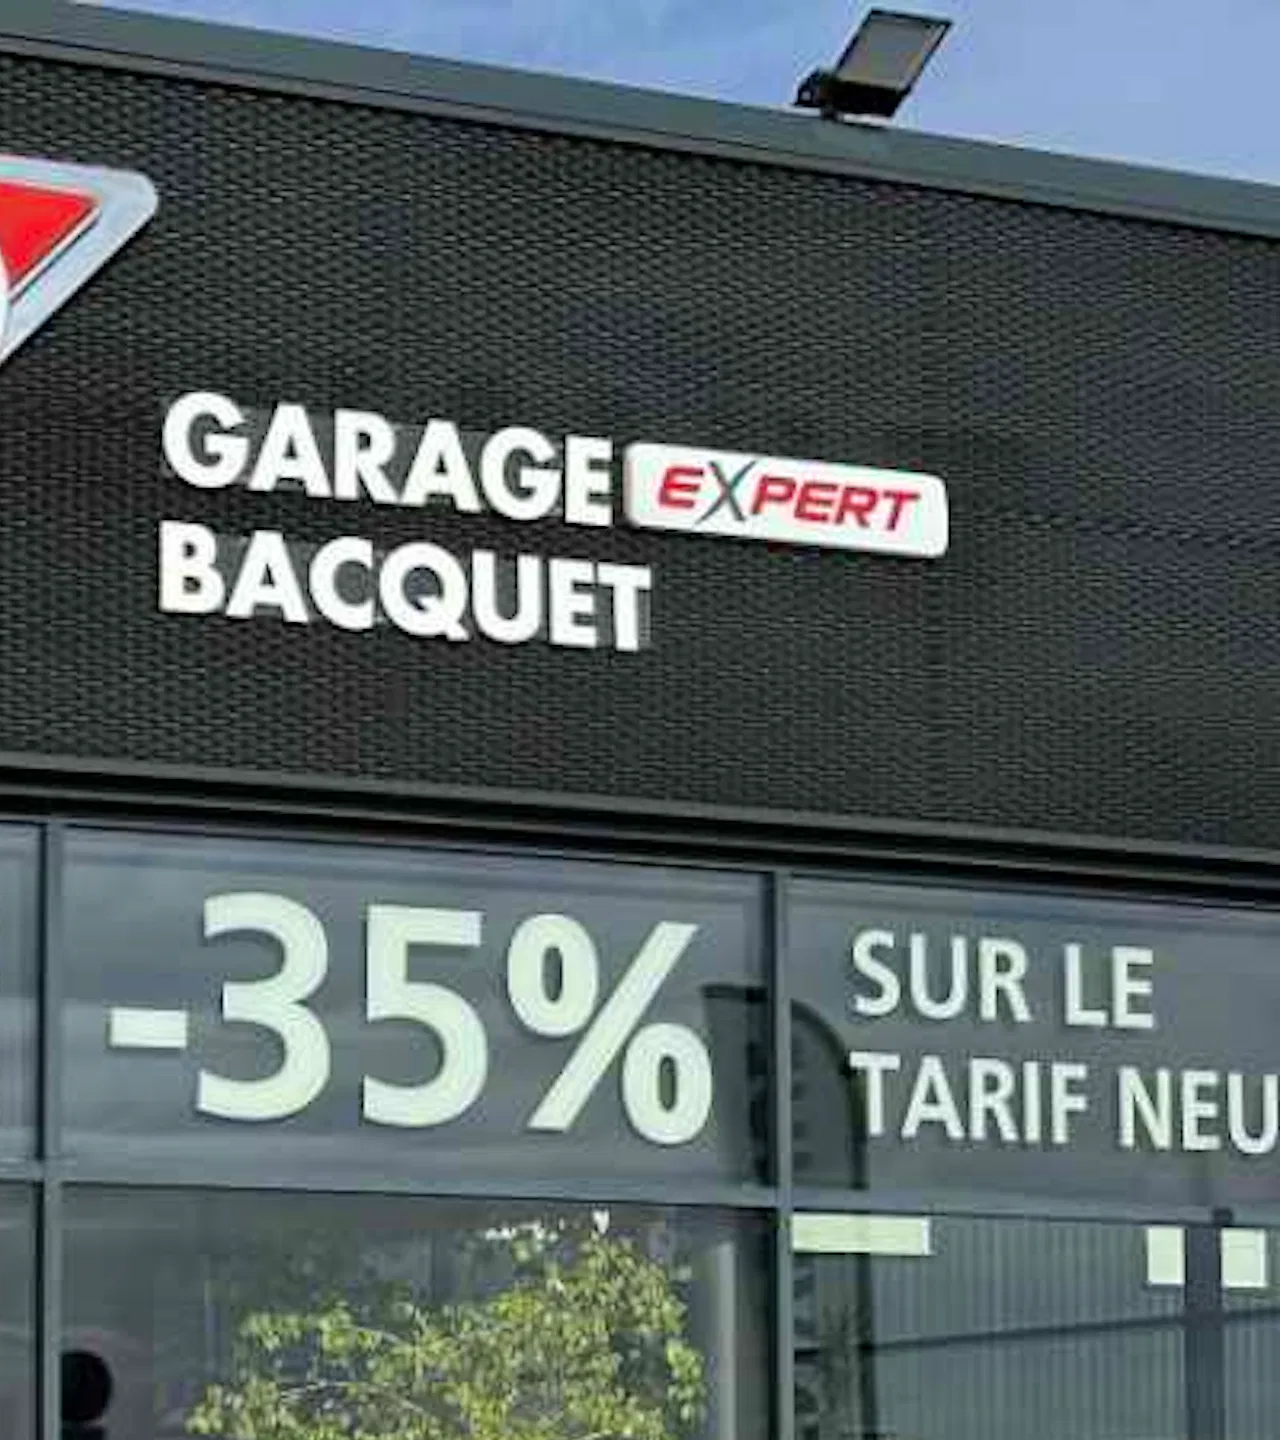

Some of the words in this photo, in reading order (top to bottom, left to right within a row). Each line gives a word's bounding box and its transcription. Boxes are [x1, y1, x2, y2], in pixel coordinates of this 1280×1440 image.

[161, 390, 614, 527] GARAGE
[657, 460, 921, 532] EXPERT
[159, 519, 653, 652] BACQUET
[109, 891, 713, 1145] -35%
[852, 929, 1032, 1023] SUR
[1064, 943, 1156, 1030] LE
[849, 1050, 1088, 1144] TARIF
[1119, 1066, 1279, 1155] NEU
